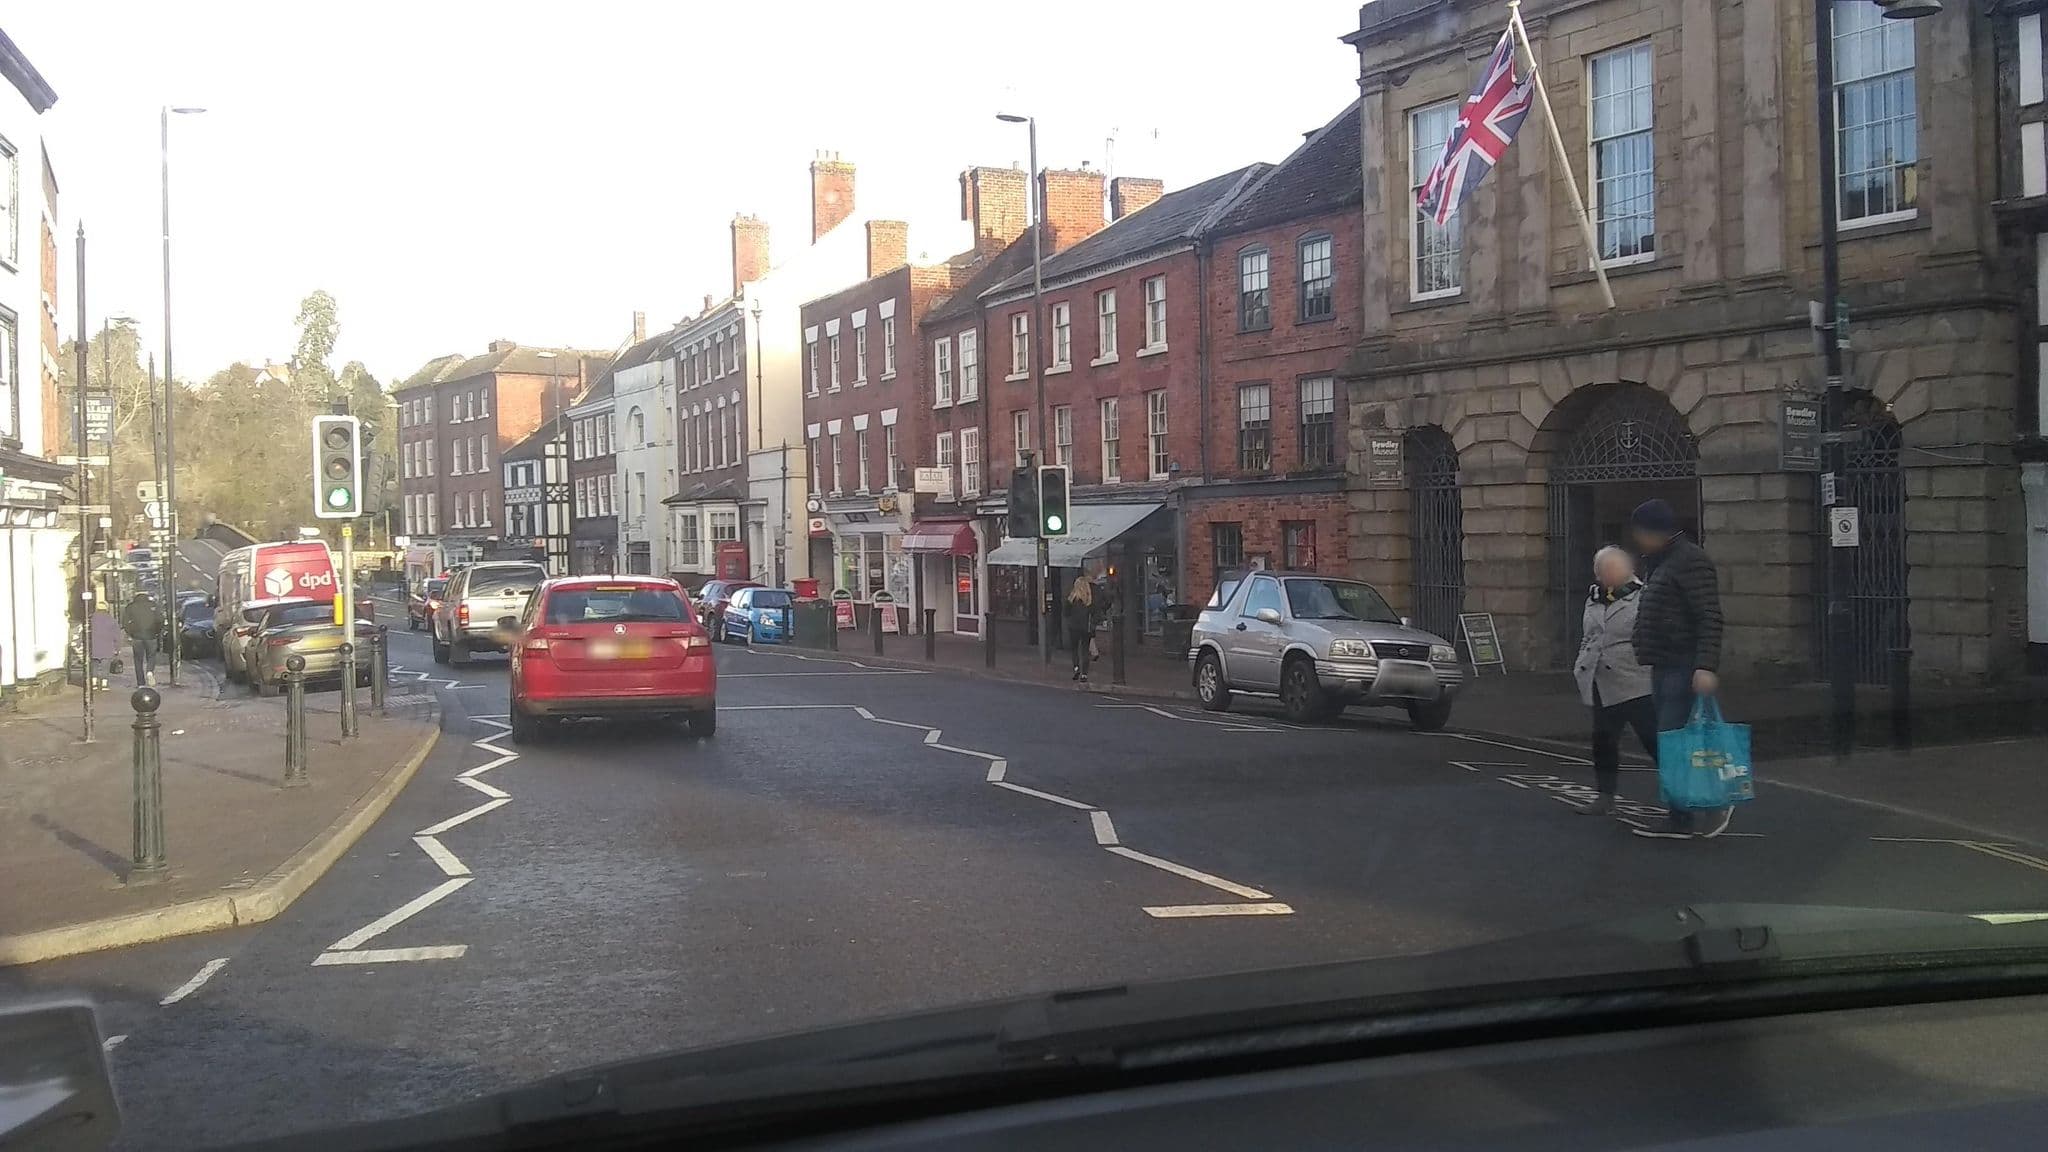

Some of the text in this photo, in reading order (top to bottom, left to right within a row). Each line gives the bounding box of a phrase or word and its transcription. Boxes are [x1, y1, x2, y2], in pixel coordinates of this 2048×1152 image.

[1786, 406, 1817, 420] Bewdley
[1786, 415, 1817, 426] Museum
[1371, 440, 1400, 450] Bewdley
[1372, 447, 1400, 456] Museum
[299, 570, 332, 590] dpd
